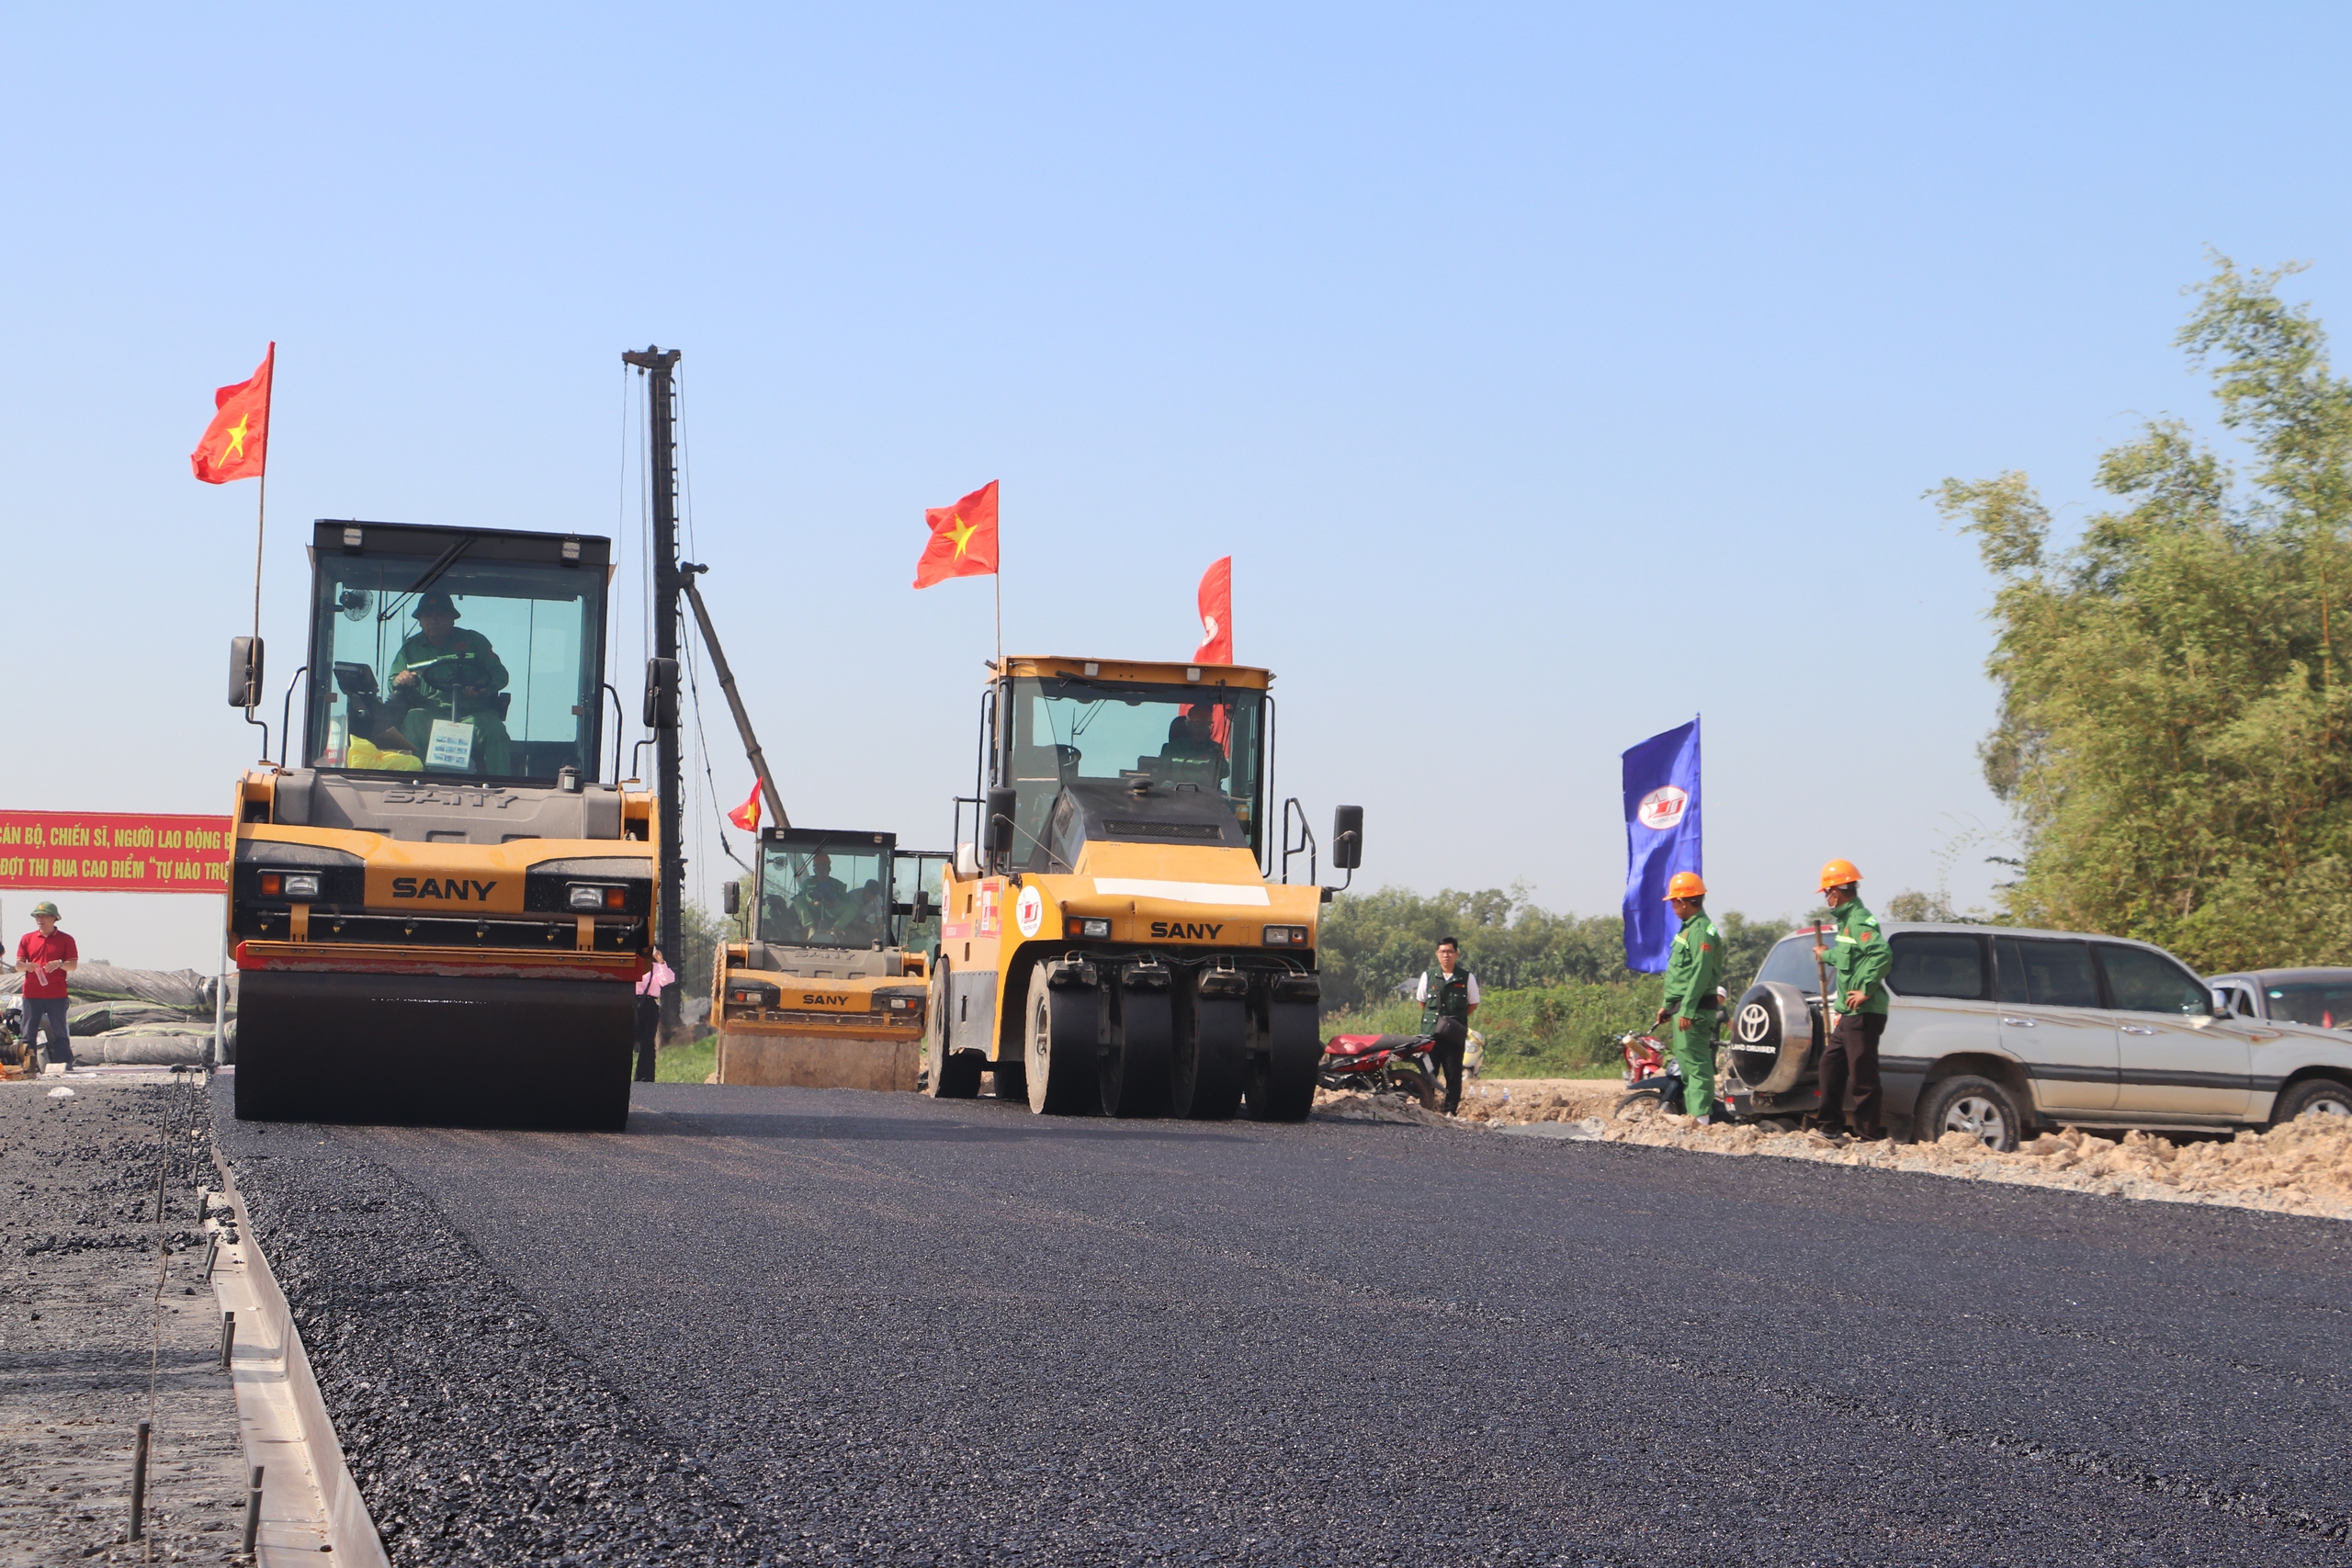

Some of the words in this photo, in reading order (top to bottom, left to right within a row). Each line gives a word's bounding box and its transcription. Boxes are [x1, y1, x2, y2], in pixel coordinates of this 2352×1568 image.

[382, 789, 518, 809] SANY
[0, 822, 21, 844] ÁN
[25, 823, 46, 849] BỘ,
[50, 822, 90, 847] CHIẾN
[93, 825, 110, 849] SĨ,
[114, 825, 154, 848] NGƯỜI
[157, 829, 182, 849] LAO
[185, 827, 221, 852] ĐỘNG
[0, 855, 25, 880] ĐỢT
[28, 858, 50, 877] THI
[52, 859, 78, 877] ĐUA
[82, 859, 108, 878] CAO
[111, 852, 145, 879] ĐIỂM
[175, 857, 201, 880] HÀO
[392, 877, 498, 901] SANY
[1150, 921, 1224, 940] SANY
[802, 994, 849, 1006] SANY
